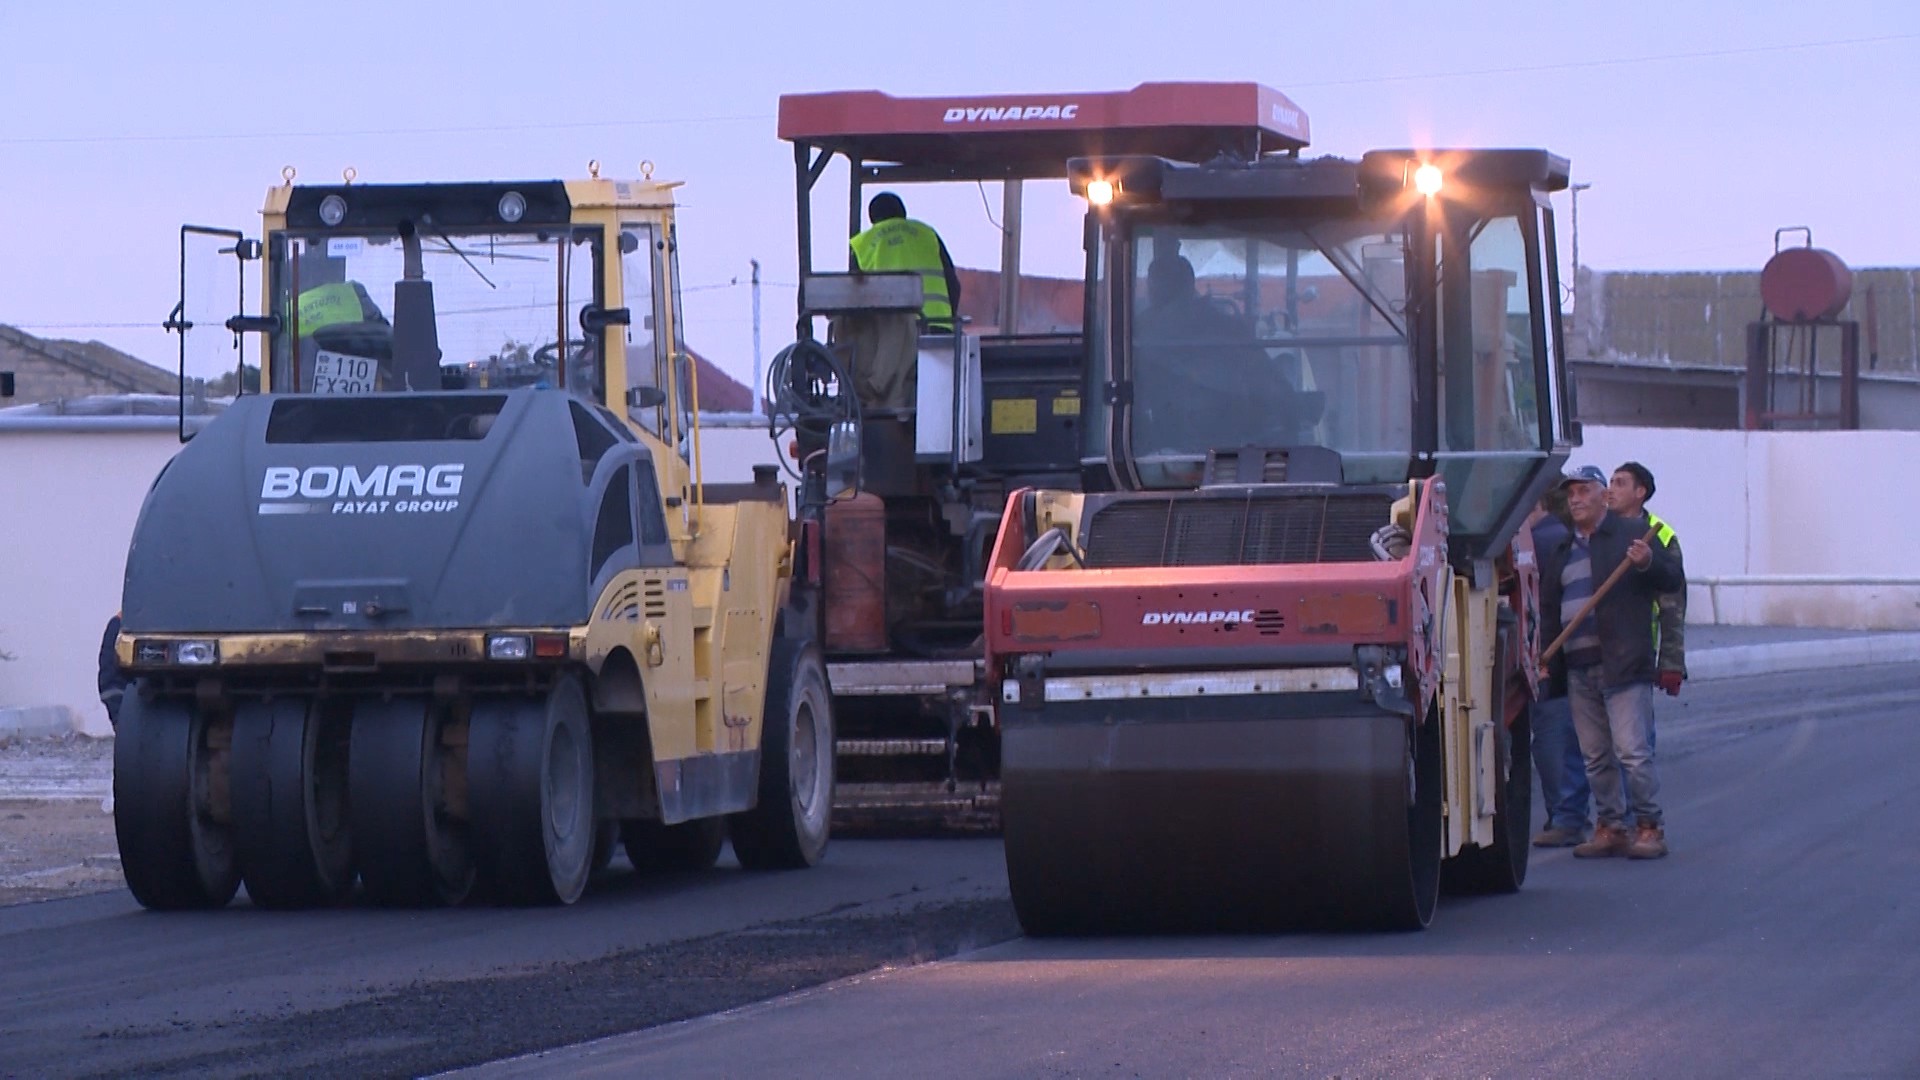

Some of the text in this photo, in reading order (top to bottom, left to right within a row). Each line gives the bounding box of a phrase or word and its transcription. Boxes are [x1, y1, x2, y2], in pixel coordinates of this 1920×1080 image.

[943, 104, 1079, 122] DYNAPAC
[336, 357, 369, 380] 110
[261, 463, 465, 498] BOMAG
[331, 500, 459, 514] FAYAT GROUP
[1142, 610, 1255, 625] DYNAPAC
